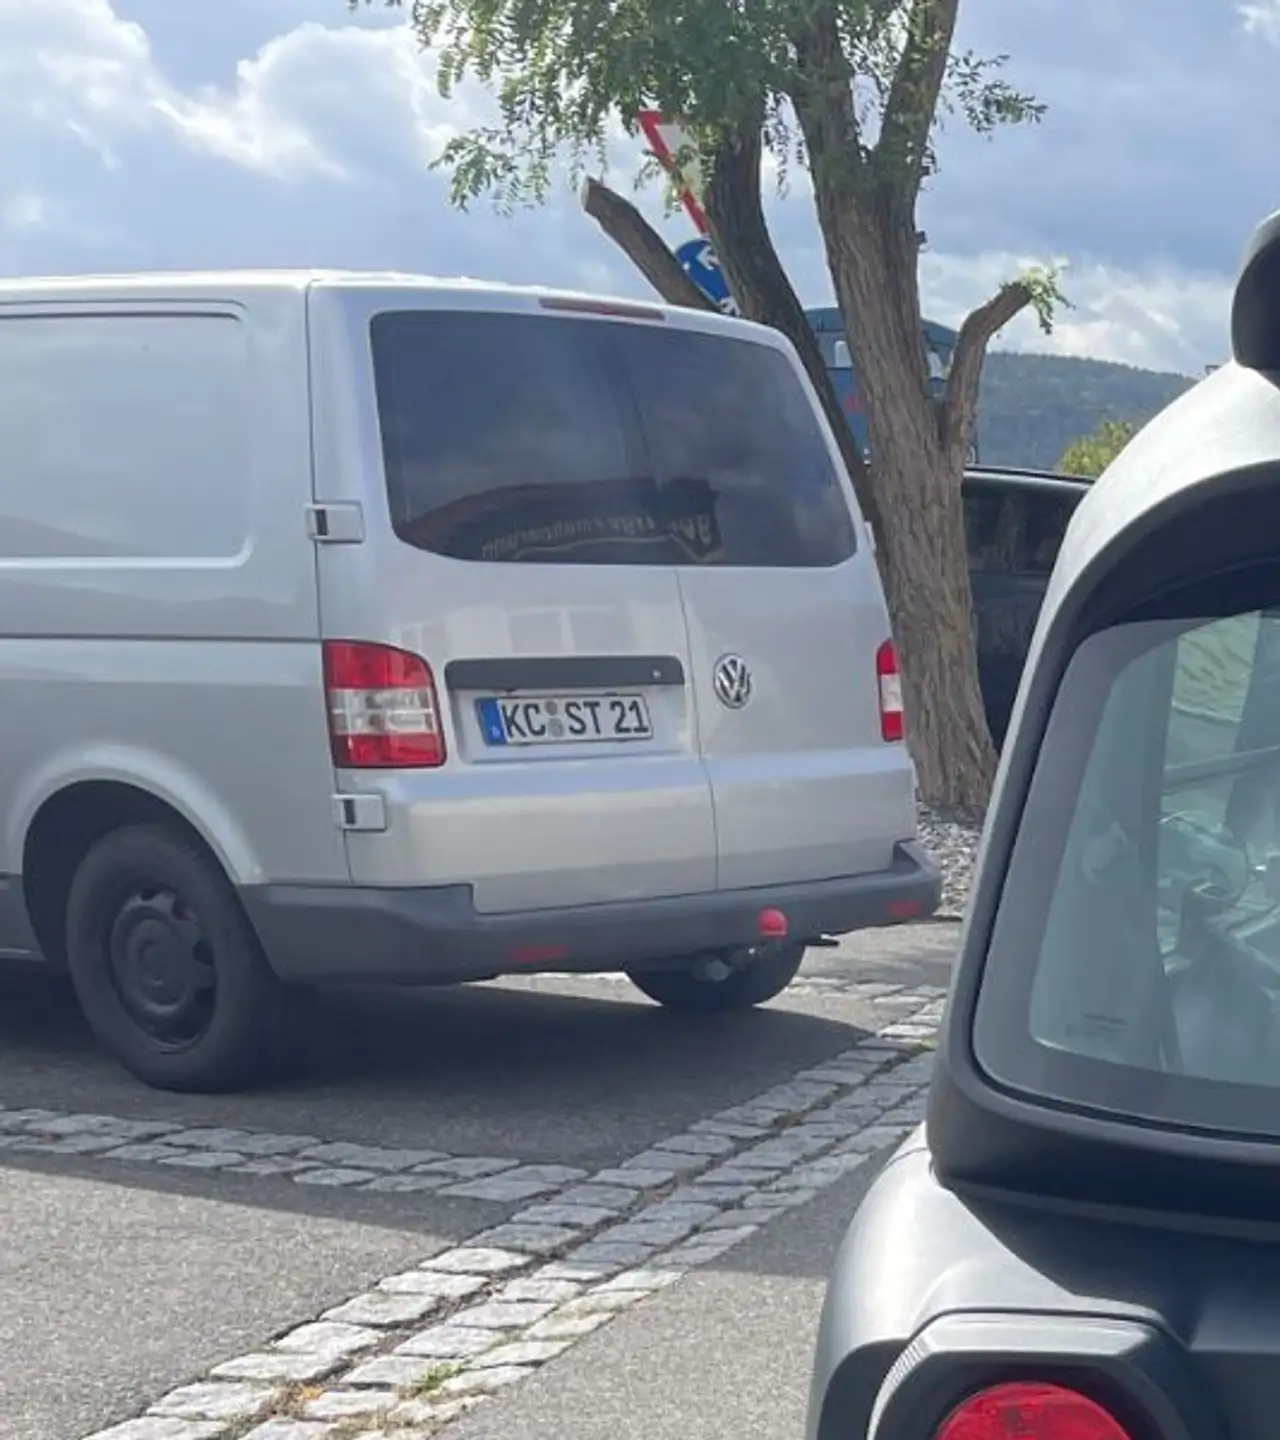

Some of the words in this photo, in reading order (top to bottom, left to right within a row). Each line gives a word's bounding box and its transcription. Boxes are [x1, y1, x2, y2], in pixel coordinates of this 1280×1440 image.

[501, 703, 546, 738] KC
[564, 701, 602, 735] ST
[609, 700, 649, 733] 21
